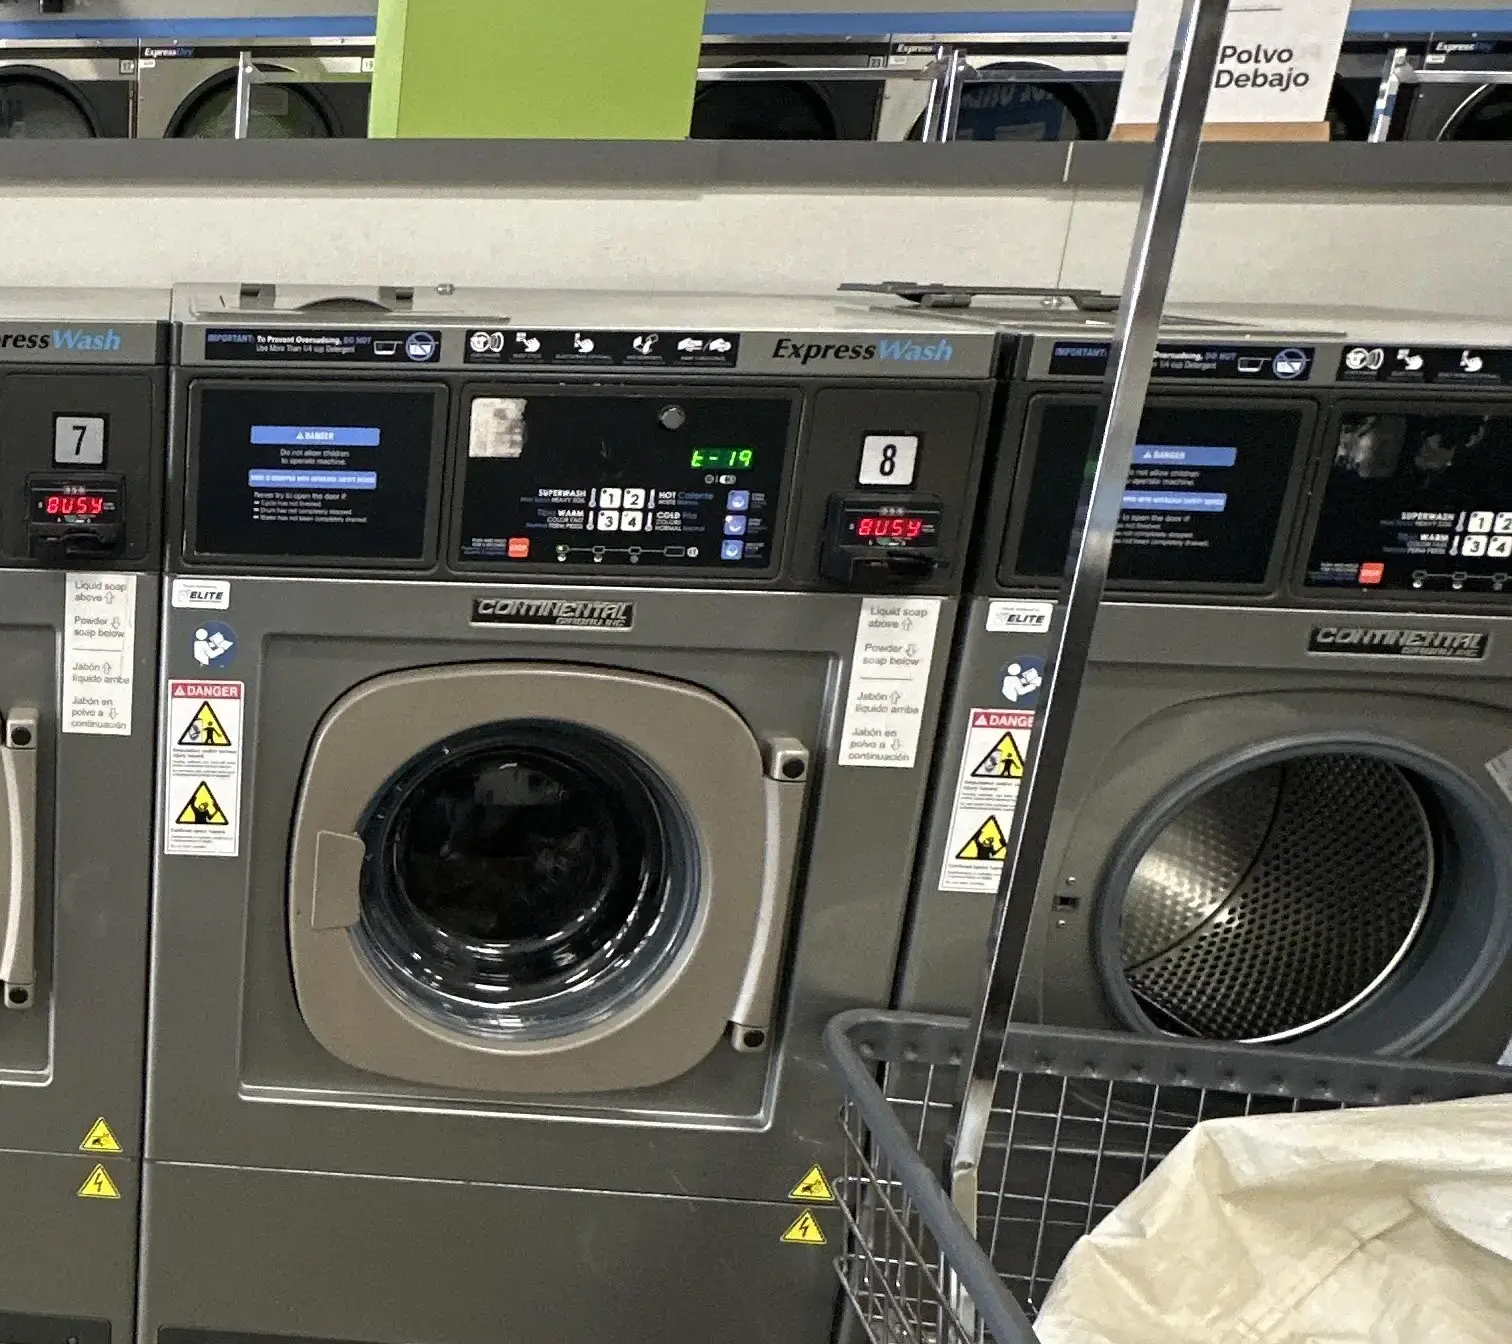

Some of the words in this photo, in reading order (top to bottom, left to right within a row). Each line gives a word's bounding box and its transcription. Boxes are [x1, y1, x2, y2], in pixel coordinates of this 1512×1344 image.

[1219, 45, 1294, 65] Polvo
[1214, 68, 1310, 92] Debajo
[772, 337, 953, 365] ExpressWash
[72, 425, 87, 456] 7
[691, 449, 753, 468] t-19
[879, 444, 897, 476] 8
[538, 488, 586, 497] SUPERWASH
[659, 491, 676, 499] HOT
[46, 496, 103, 514] BUSY
[558, 509, 584, 517] WARM
[656, 511, 681, 519] COLD
[858, 518, 922, 537] BUSY
[1420, 534, 1449, 542] WARM
[74, 581, 102, 591] Liquid
[104, 582, 127, 592] soap
[74, 593, 102, 602] above
[189, 590, 223, 600] ELITE
[477, 599, 628, 619] CONTINENTAL
[870, 606, 901, 617] Liquid
[903, 608, 928, 618] soap
[74, 616, 109, 625] Powder
[868, 619, 899, 628] above
[1006, 614, 1045, 626] ELITE
[74, 629, 95, 638] soap
[98, 628, 125, 638] below
[1316, 627, 1483, 648] CONTINENTAL
[864, 643, 903, 653] Powder
[73, 662, 100, 671] Jabón
[862, 658, 887, 666] soap
[889, 657, 919, 666] below
[187, 686, 238, 697] DANGER
[857, 692, 888, 701] Jabón
[72, 696, 99, 705] Jabón
[71, 709, 96, 718] polvo
[989, 714, 1034, 728] DANGE
[852, 727, 882, 737] Jabón
[884, 730, 897, 738] en
[849, 740, 876, 750] polvo
